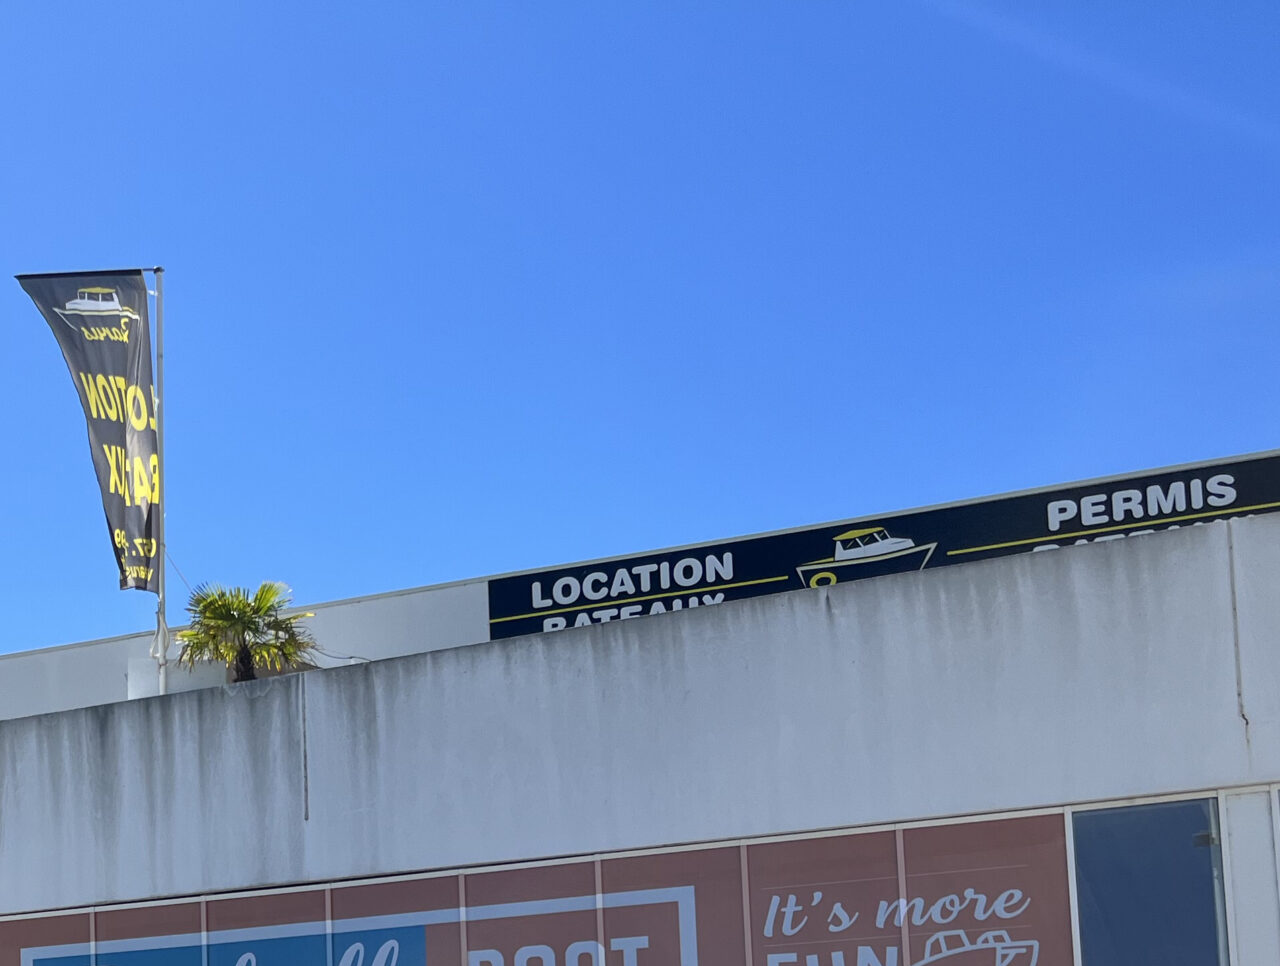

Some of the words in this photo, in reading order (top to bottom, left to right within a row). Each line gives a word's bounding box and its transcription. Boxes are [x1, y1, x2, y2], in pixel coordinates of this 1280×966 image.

[1047, 474, 1237, 531] PERMIS
[532, 552, 733, 608] LOCATION
[763, 890, 858, 938] It's
[875, 887, 1031, 931] more
